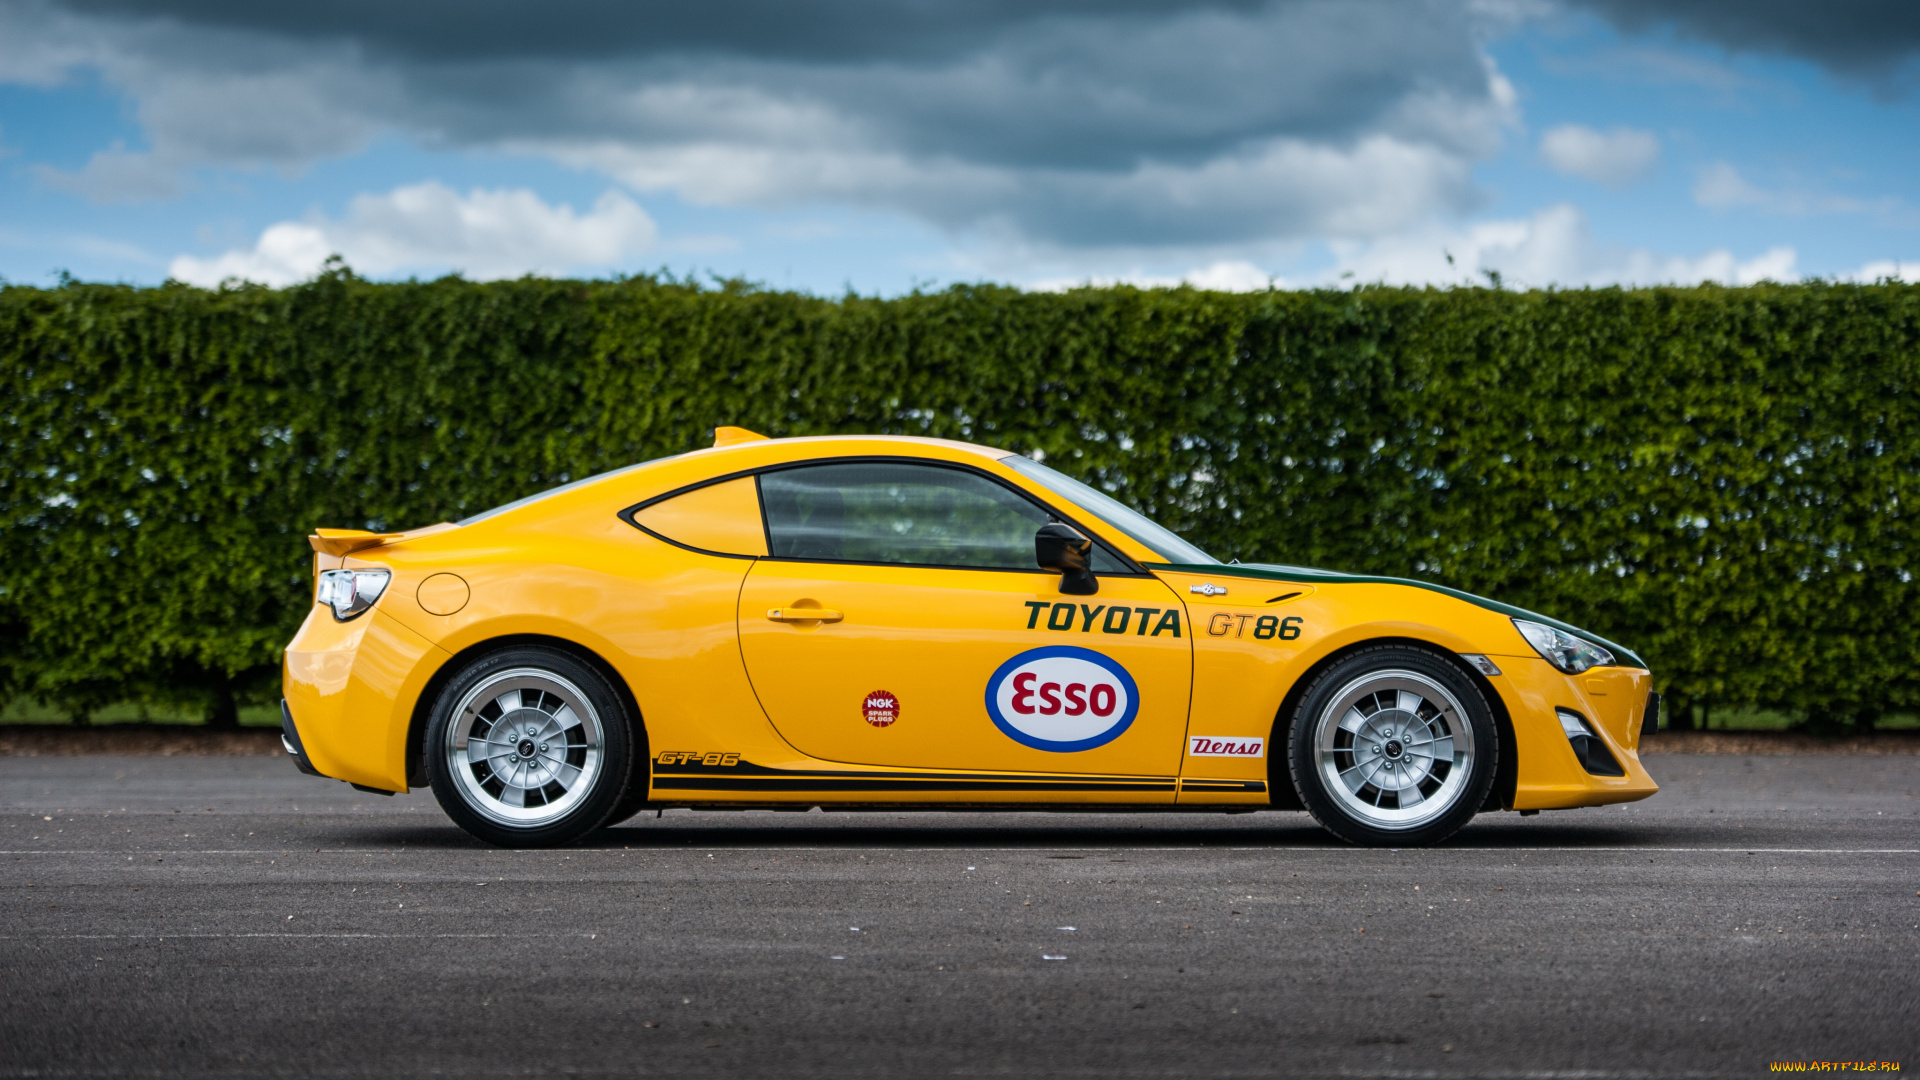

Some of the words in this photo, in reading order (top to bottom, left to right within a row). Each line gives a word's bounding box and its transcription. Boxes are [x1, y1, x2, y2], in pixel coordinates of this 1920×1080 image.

[1024, 600, 1182, 638] TOYOTA
[1206, 612, 1304, 640] GT86
[867, 698, 894, 708] NGK
[1192, 738, 1261, 755] Denso
[657, 751, 740, 767] GT-86
